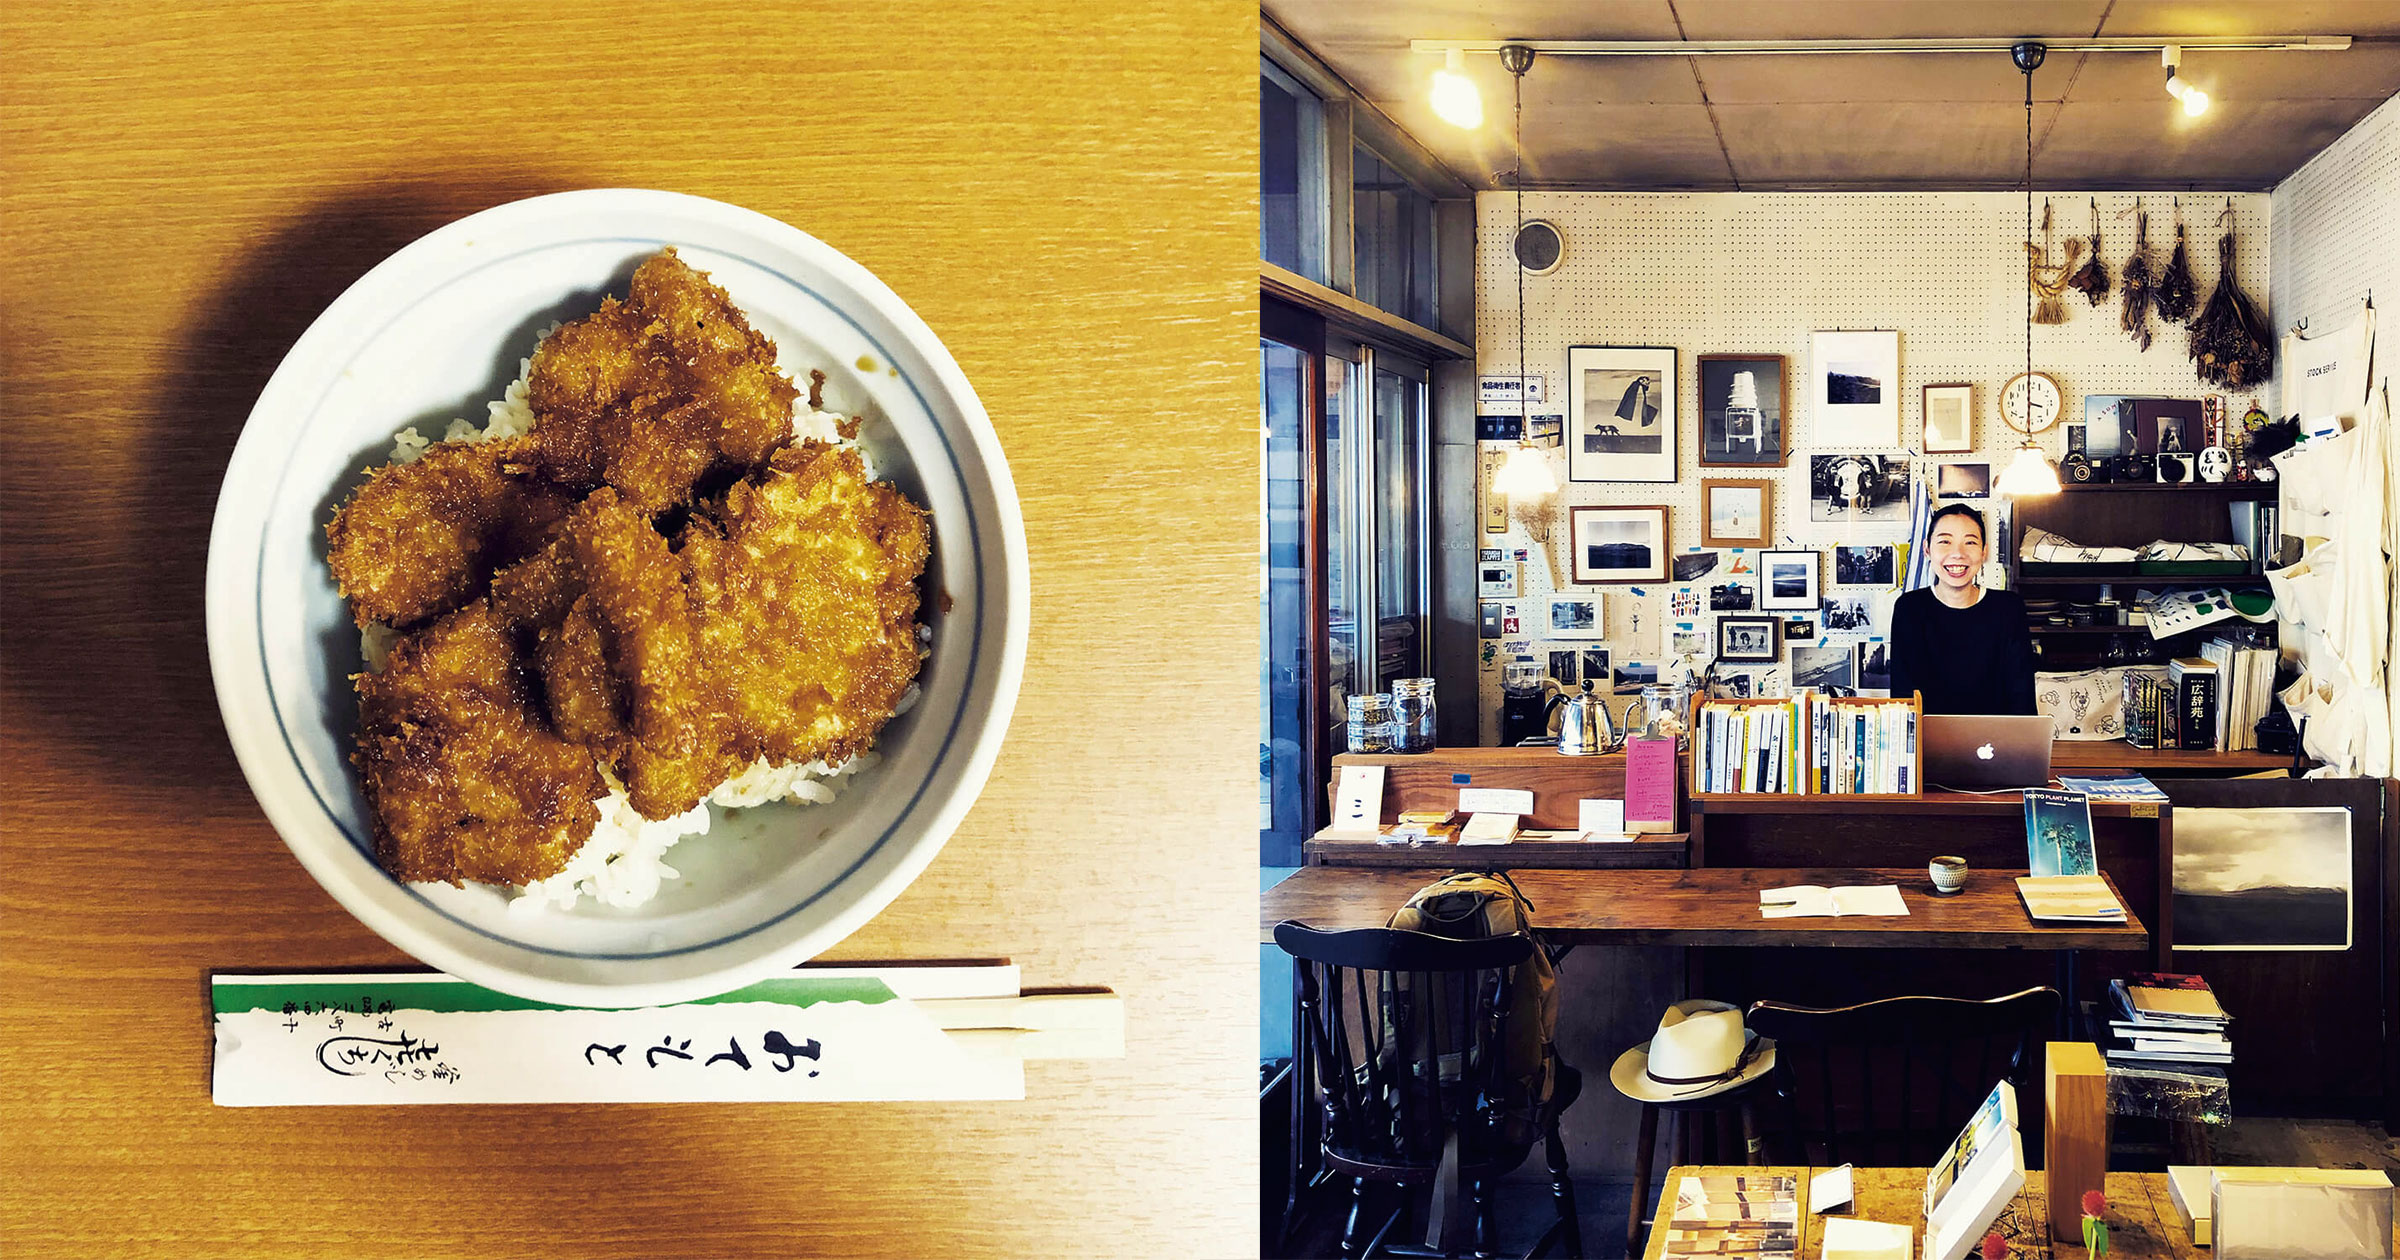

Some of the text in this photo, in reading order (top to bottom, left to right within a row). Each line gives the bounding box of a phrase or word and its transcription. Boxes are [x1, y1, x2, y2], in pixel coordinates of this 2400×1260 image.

[2189, 684, 2204, 718] 広辞苑
[584, 1029, 822, 1079] おてもと
